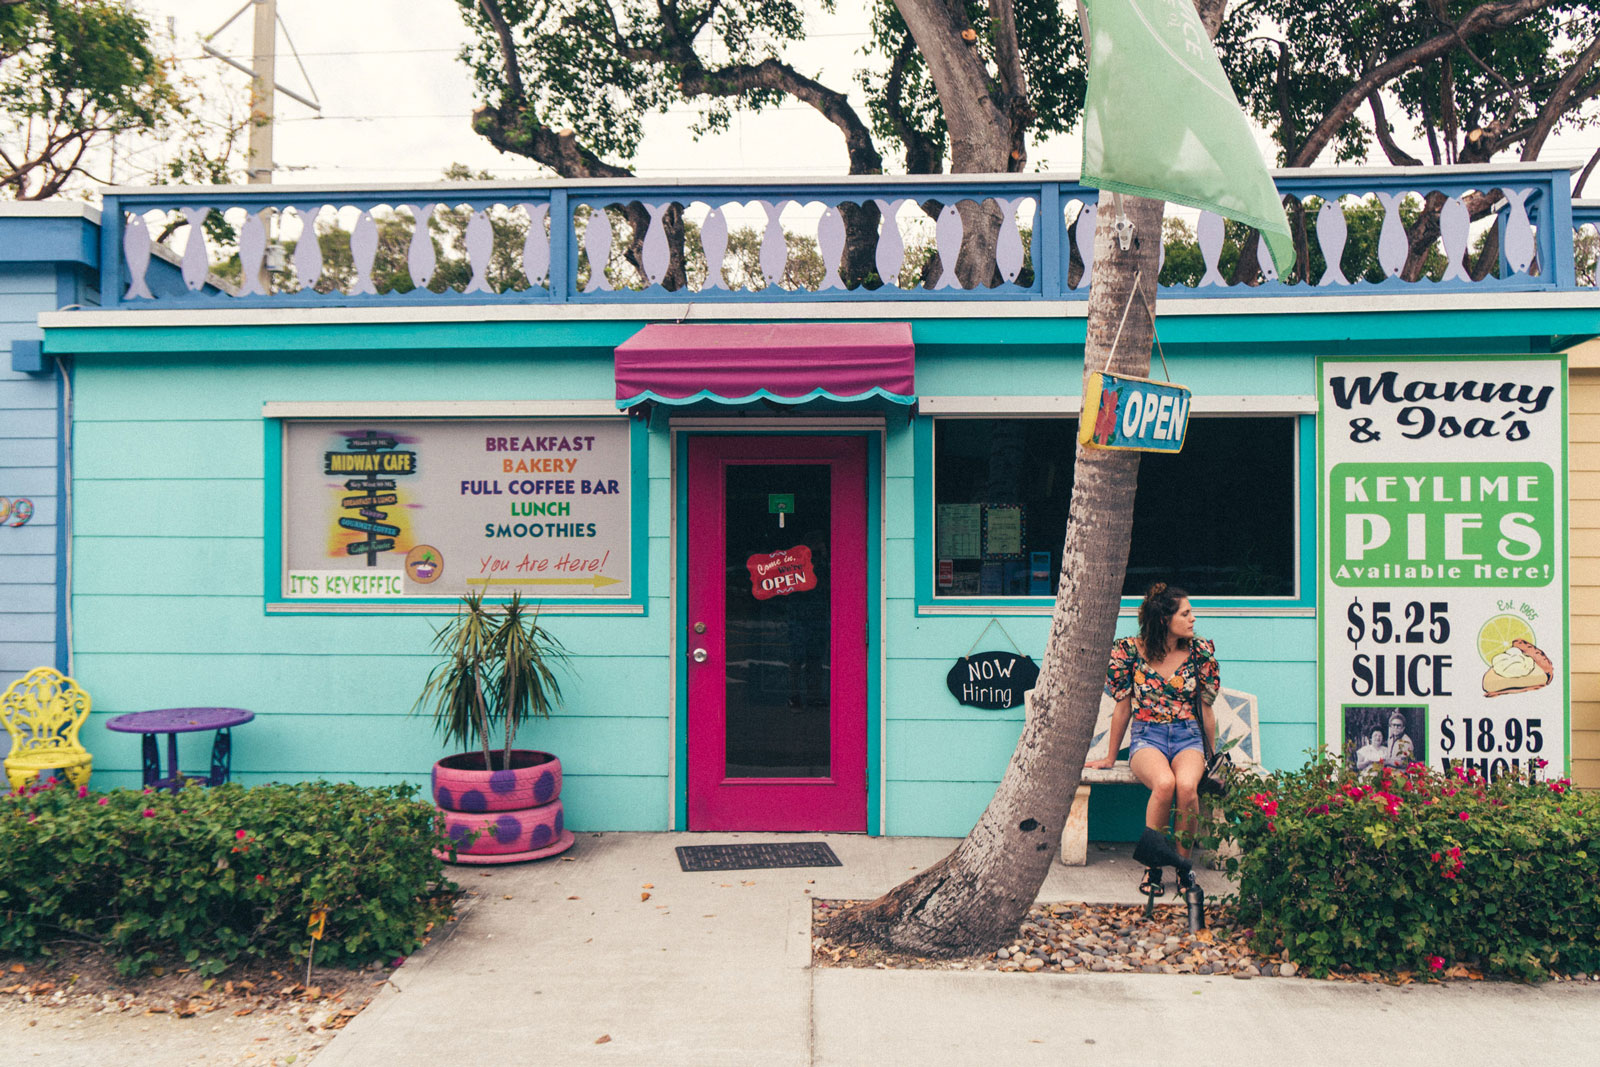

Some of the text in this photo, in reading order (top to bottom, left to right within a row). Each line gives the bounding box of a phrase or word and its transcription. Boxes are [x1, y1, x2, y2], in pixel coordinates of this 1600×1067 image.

[1330, 371, 1554, 414] Manny
[1122, 390, 1188, 441] OPEN
[1349, 417, 1381, 443] &
[486, 436, 595, 451] BREAKFAST
[331, 454, 410, 471] MIDWAY CAFE
[502, 458, 578, 473] BAKERY
[461, 480, 620, 495] FULL COFFEE BAR
[1345, 476, 1539, 502] KEYLIME
[511, 502, 570, 516] LUNCH
[373, 525, 397, 535] COFFEE
[485, 523, 596, 537] SMOOTHIES
[1345, 512, 1542, 561] PIES
[480, 550, 610, 573] You Are Here!
[758, 558, 781, 575] Come
[1336, 564, 1550, 579] Available Here!
[291, 575, 401, 594] IT'S KEYRIFFIC
[762, 572, 806, 590] OPEN
[1347, 596, 1450, 650] $5.25
[968, 659, 1016, 681] NOW
[1351, 654, 1452, 697] SLICE
[963, 683, 1012, 708] Hiring
[1440, 714, 1543, 754] $18.95
